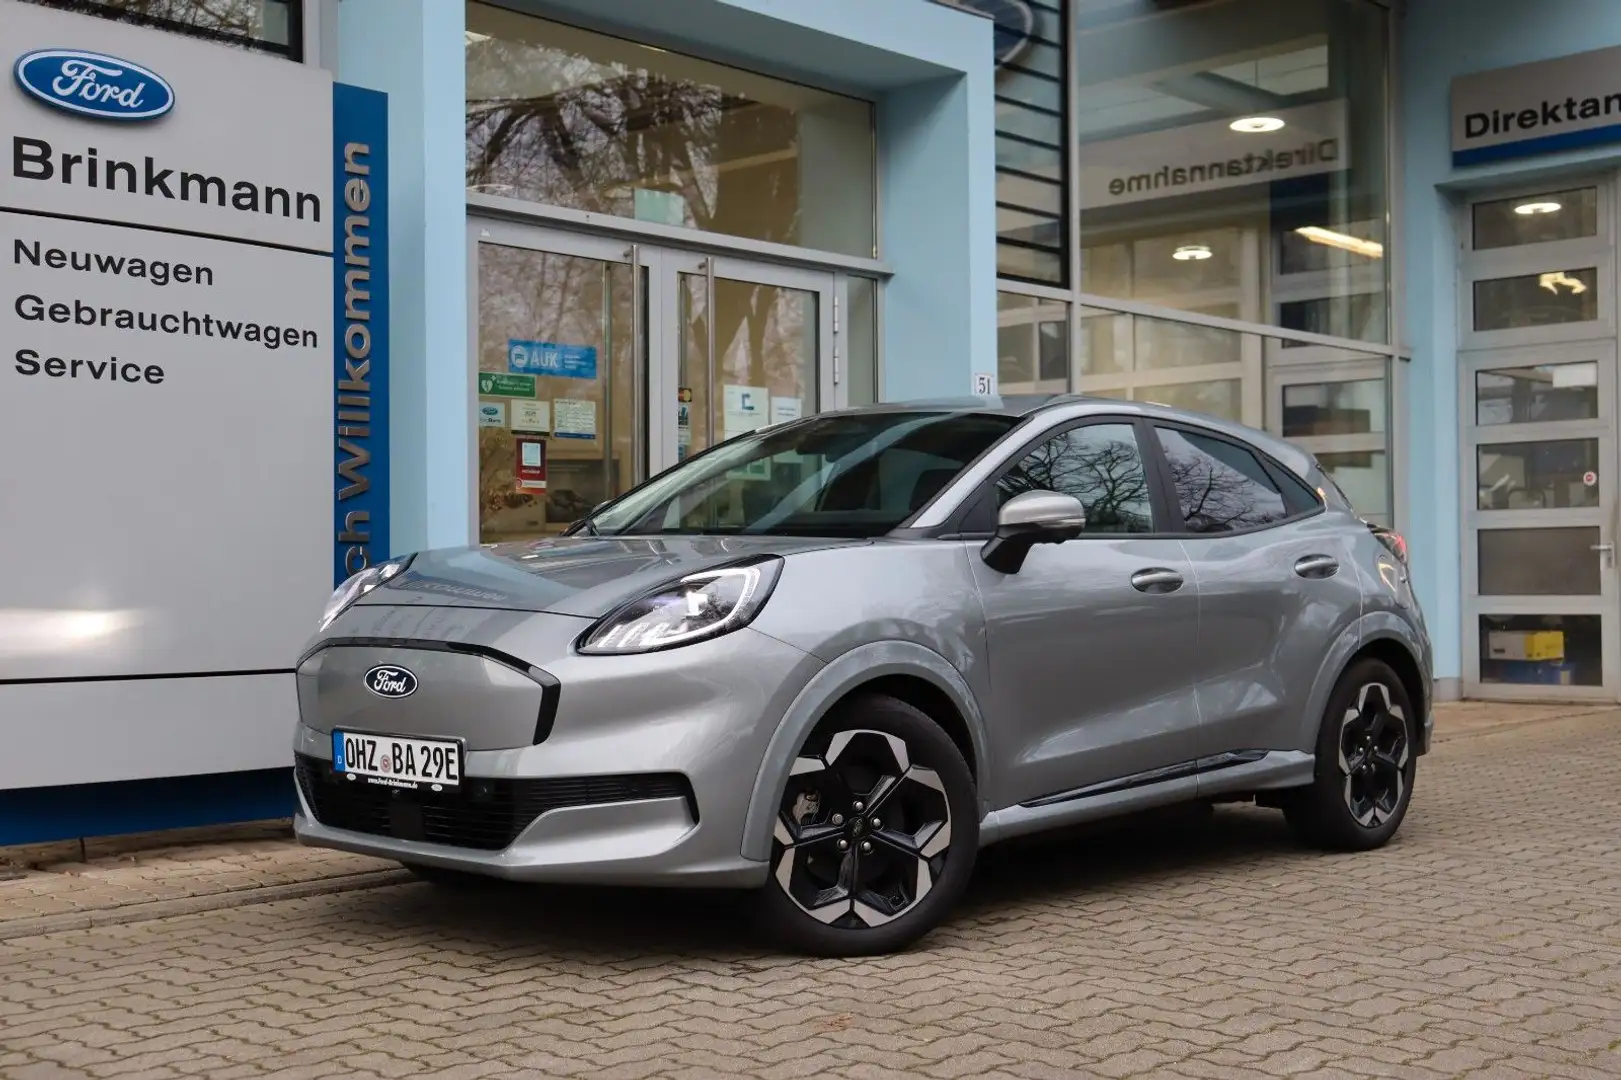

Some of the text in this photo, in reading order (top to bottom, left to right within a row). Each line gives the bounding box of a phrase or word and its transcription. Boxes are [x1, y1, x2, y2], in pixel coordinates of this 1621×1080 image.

[52, 59, 146, 109] Ford
[13, 136, 321, 223] Brinkmann
[14, 239, 214, 286] Neuwagen
[14, 294, 318, 350] Gebrauchtwagen
[338, 142, 371, 501] Willkommen
[15, 349, 165, 384] Service
[979, 376, 991, 395] 51
[373, 669, 407, 693] Ford
[345, 738, 458, 781] OHZ BA 29E
